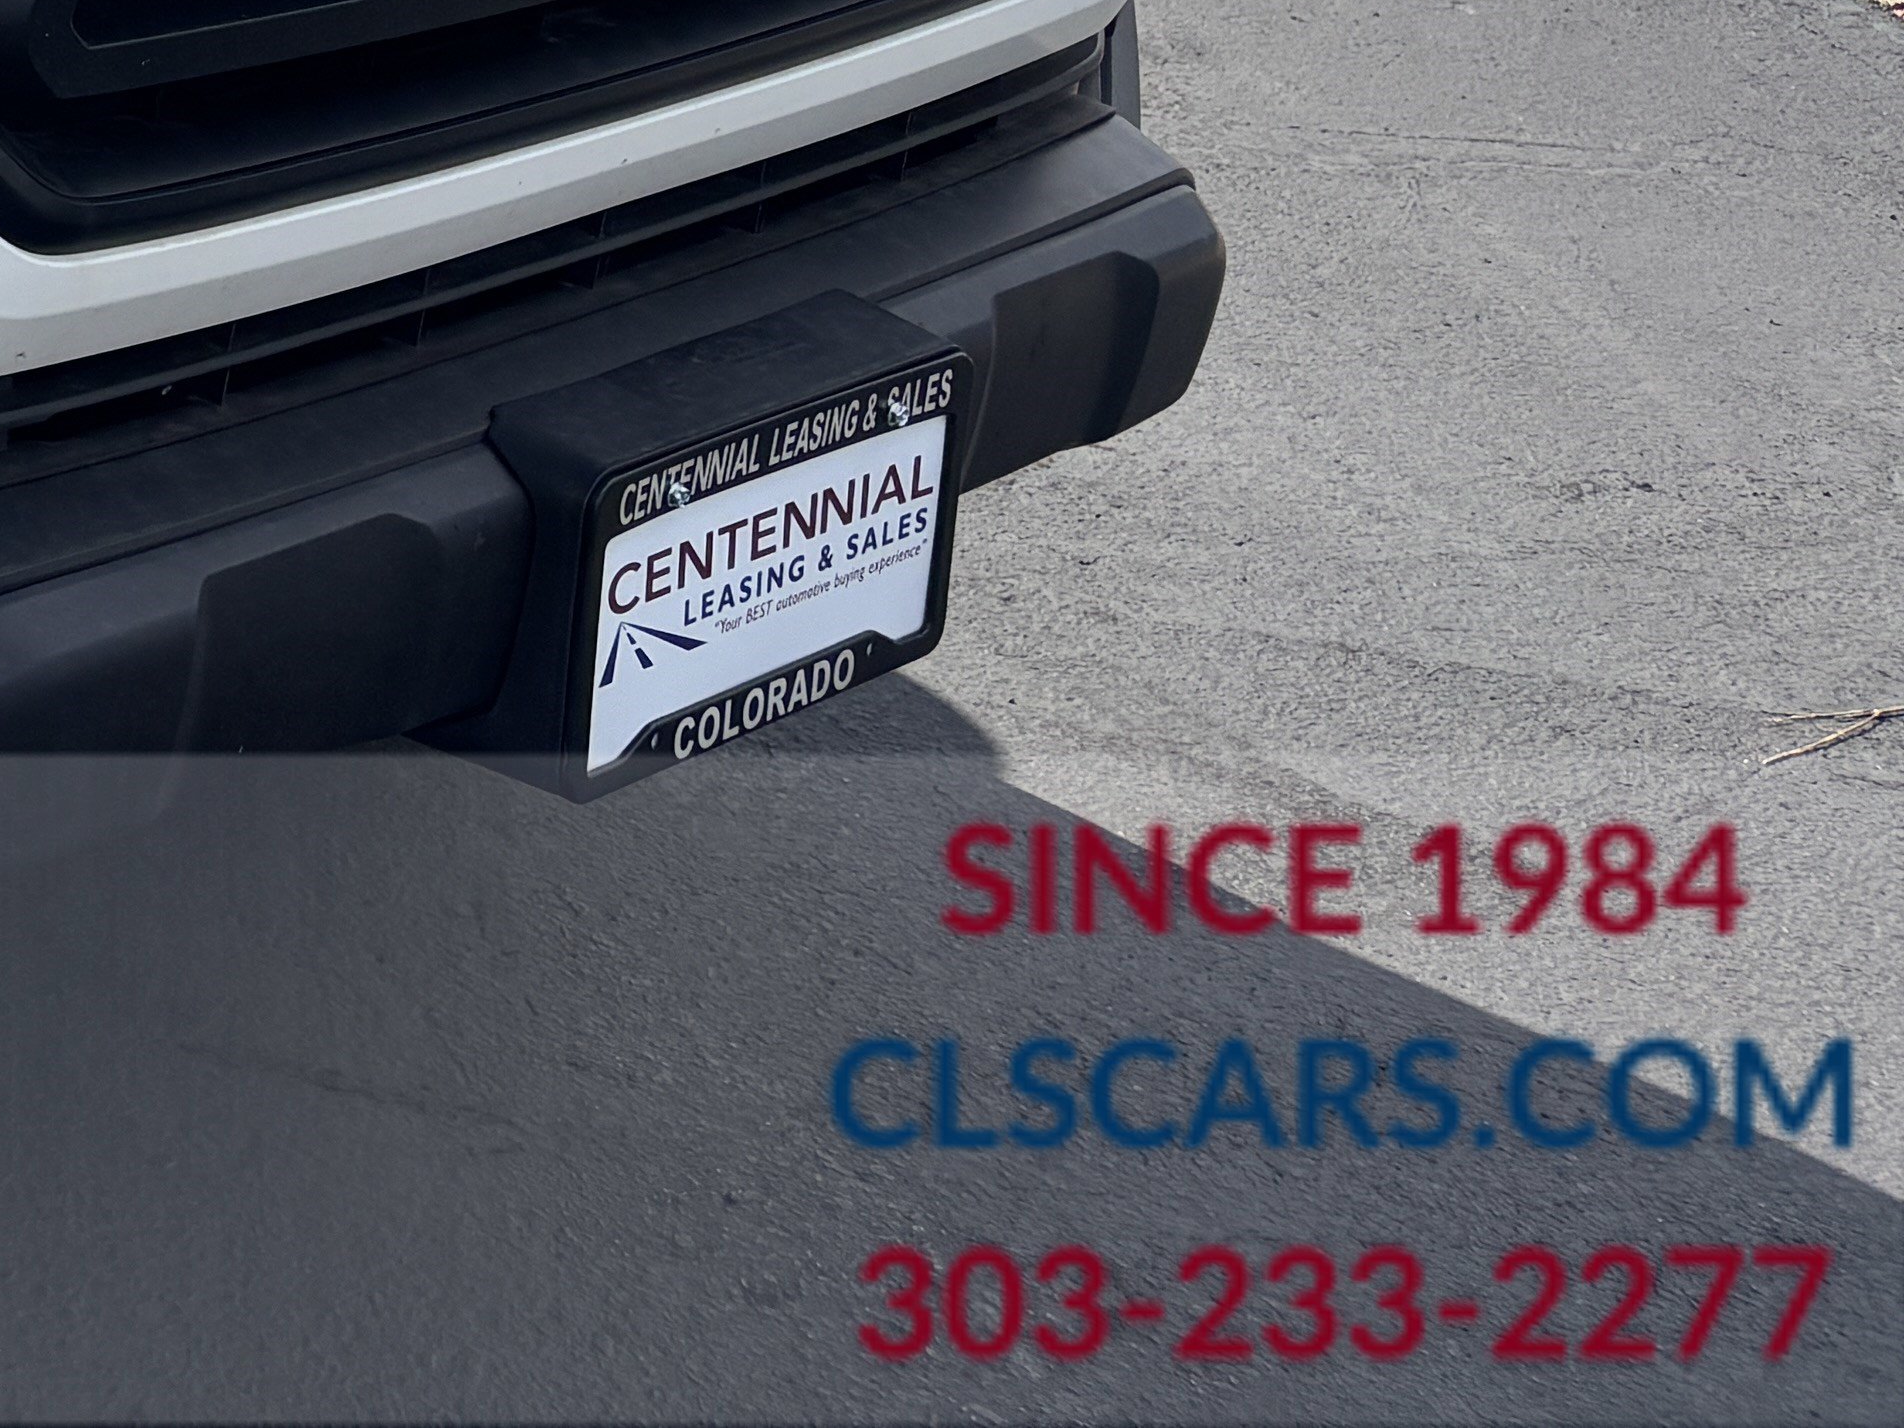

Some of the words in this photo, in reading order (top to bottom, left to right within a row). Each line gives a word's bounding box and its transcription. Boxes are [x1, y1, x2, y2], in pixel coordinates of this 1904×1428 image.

[768, 400, 857, 466] LEASING
[863, 393, 877, 432] &
[608, 455, 934, 614] CENTENNIAL
[684, 554, 805, 627] LEASING
[818, 544, 834, 572] &
[846, 507, 928, 560] SALES
[745, 600, 773, 624] BEST
[776, 581, 831, 612] automotive
[834, 566, 866, 588] buying
[673, 648, 855, 760] COLORADO
